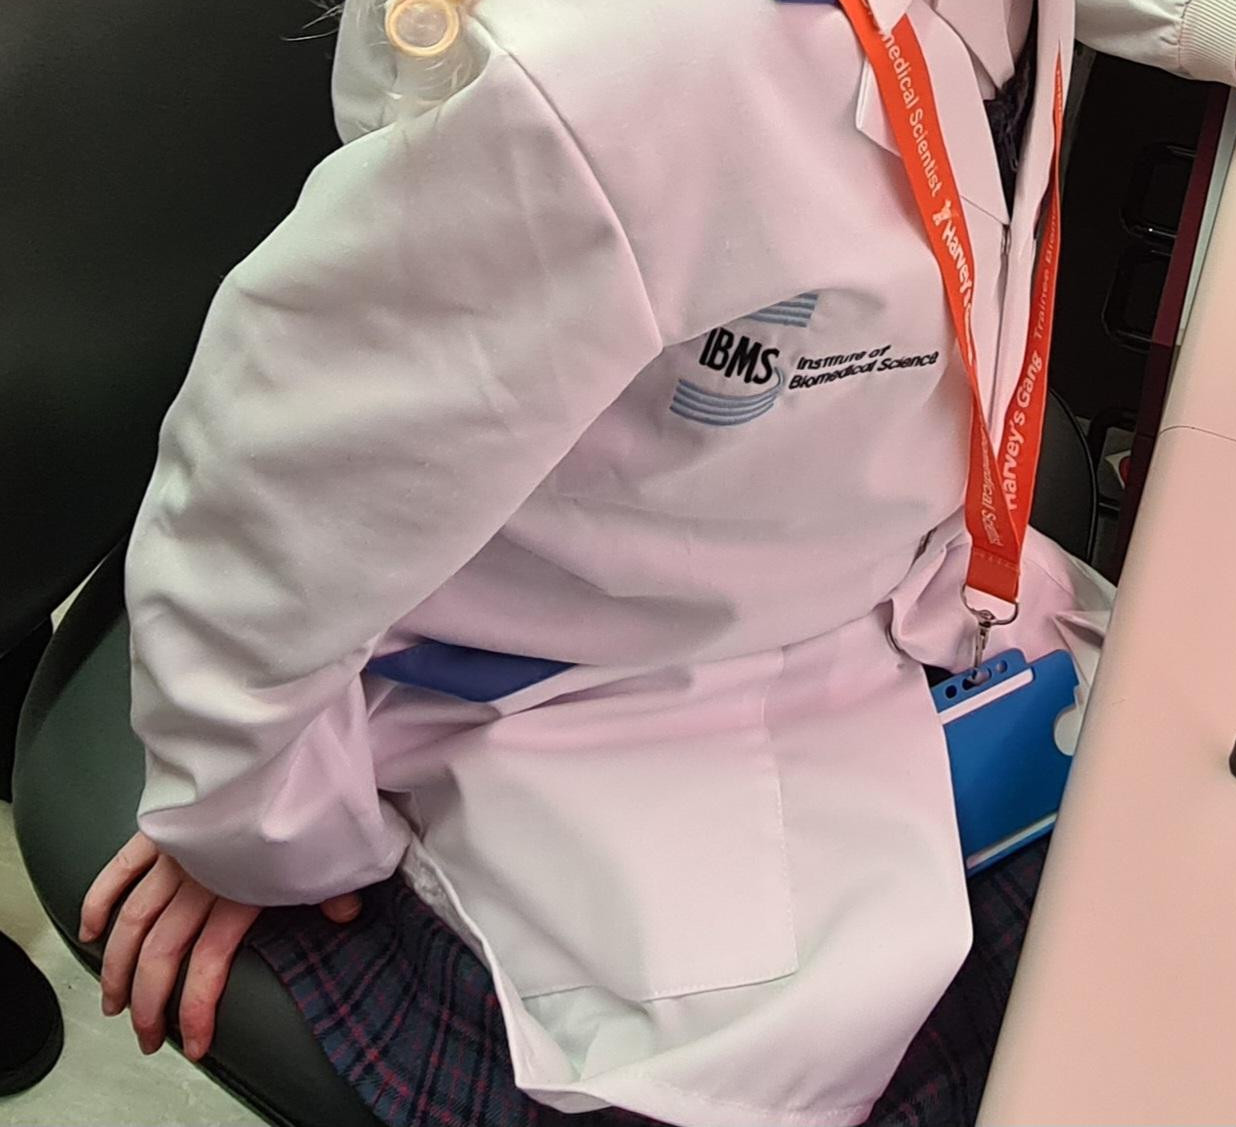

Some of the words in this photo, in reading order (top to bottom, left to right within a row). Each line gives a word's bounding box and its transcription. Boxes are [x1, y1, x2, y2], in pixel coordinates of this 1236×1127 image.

[909, 108, 943, 198] Scientist
[699, 327, 780, 384] IBMS
[789, 359, 877, 389] Biomedical
[877, 351, 940, 373] Science
[797, 351, 866, 371] Institute
[868, 345, 892, 359] of
[1016, 352, 1043, 409] Gang
